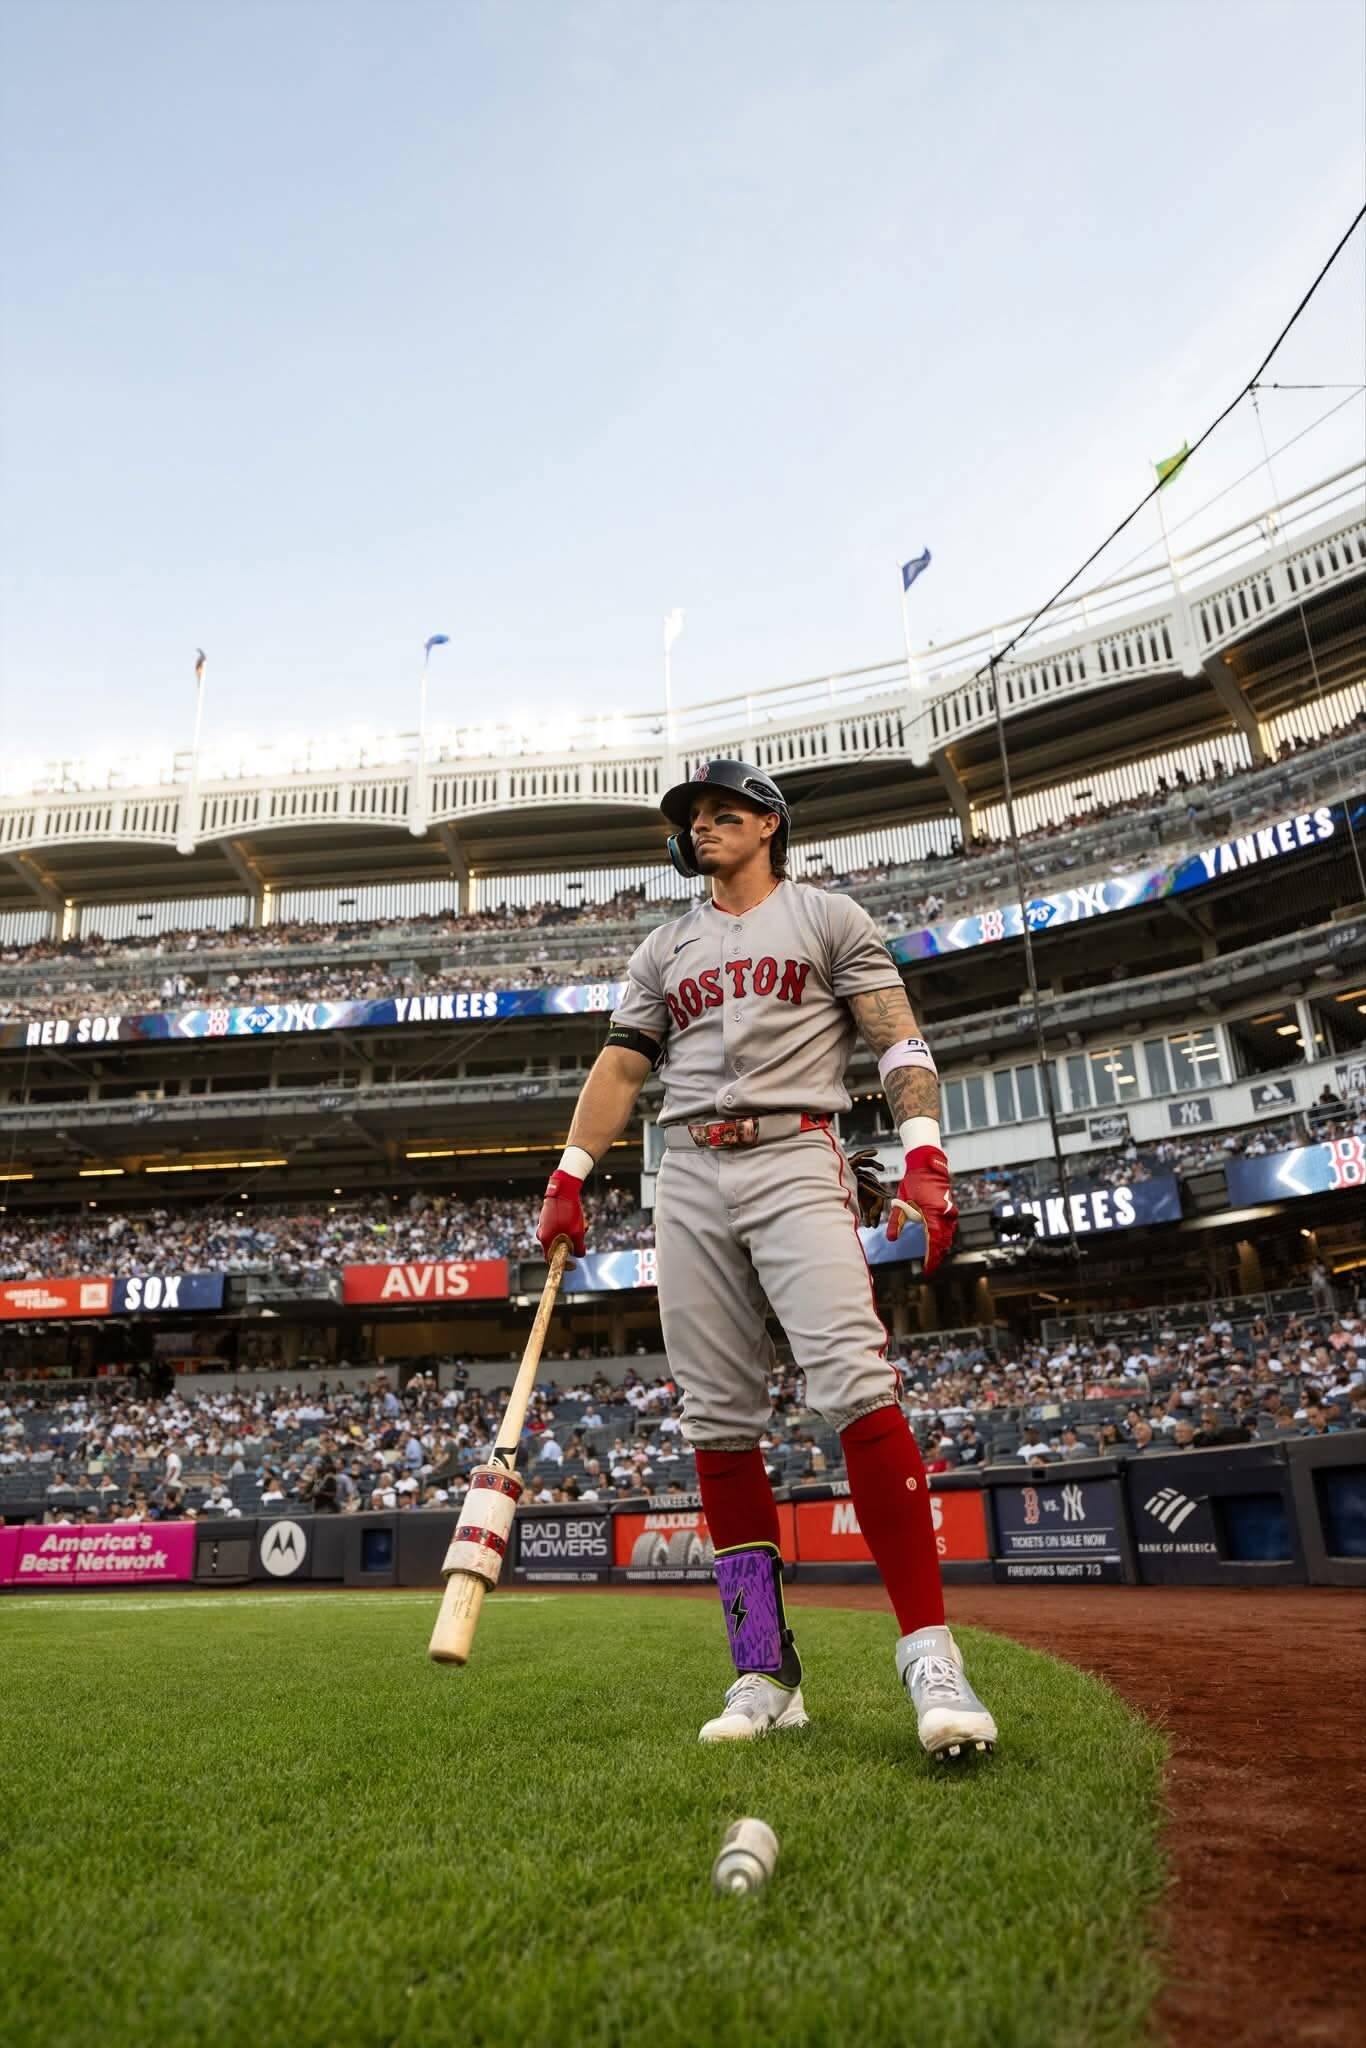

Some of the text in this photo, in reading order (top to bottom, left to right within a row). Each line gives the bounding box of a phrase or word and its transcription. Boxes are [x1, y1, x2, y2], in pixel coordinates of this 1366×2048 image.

[1201, 807, 1336, 879] YANKEES
[665, 956, 811, 1031] BOSTON
[394, 991, 499, 1022] YANKEES
[26, 1016, 122, 1045] RED SOX
[380, 1264, 470, 1299] AVIS
[124, 1276, 181, 1311] SOX
[521, 1521, 606, 1540] BAD BOY
[1011, 1533, 1107, 1548] TICKETS ON SALE NOW
[40, 1532, 153, 1553] America's
[521, 1539, 607, 1557] MOWERS
[1138, 1543, 1217, 1553] BANK OF AMERICA
[20, 1550, 168, 1572] Best Network
[1008, 1565, 1055, 1577] FIREWORKS
[1057, 1564, 1084, 1576] NIGHT
[906, 1639, 937, 1654] STORY
